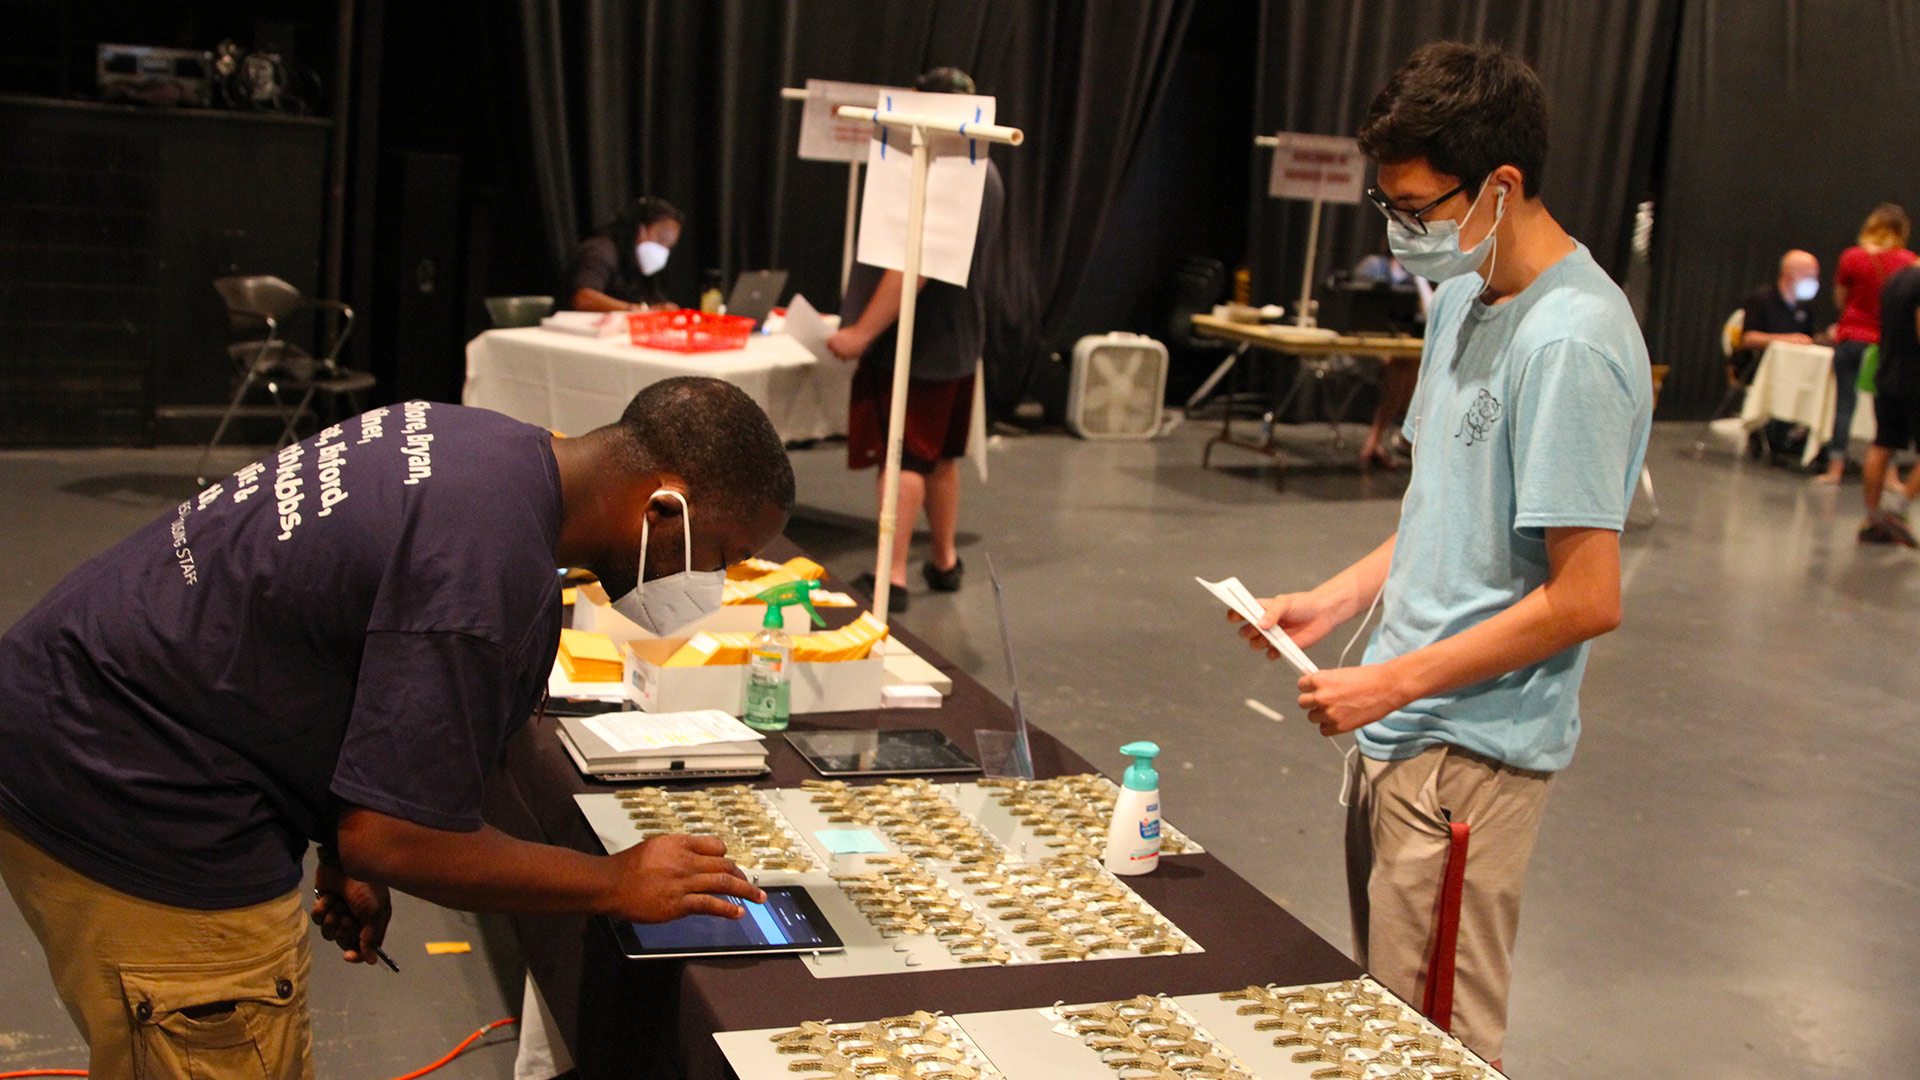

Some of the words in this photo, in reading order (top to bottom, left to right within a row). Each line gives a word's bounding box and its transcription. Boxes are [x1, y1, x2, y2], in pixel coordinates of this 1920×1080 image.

[403, 401, 431, 433] Shore,
[400, 433, 434, 485] Bryan,
[176, 548, 198, 586] STAFF
